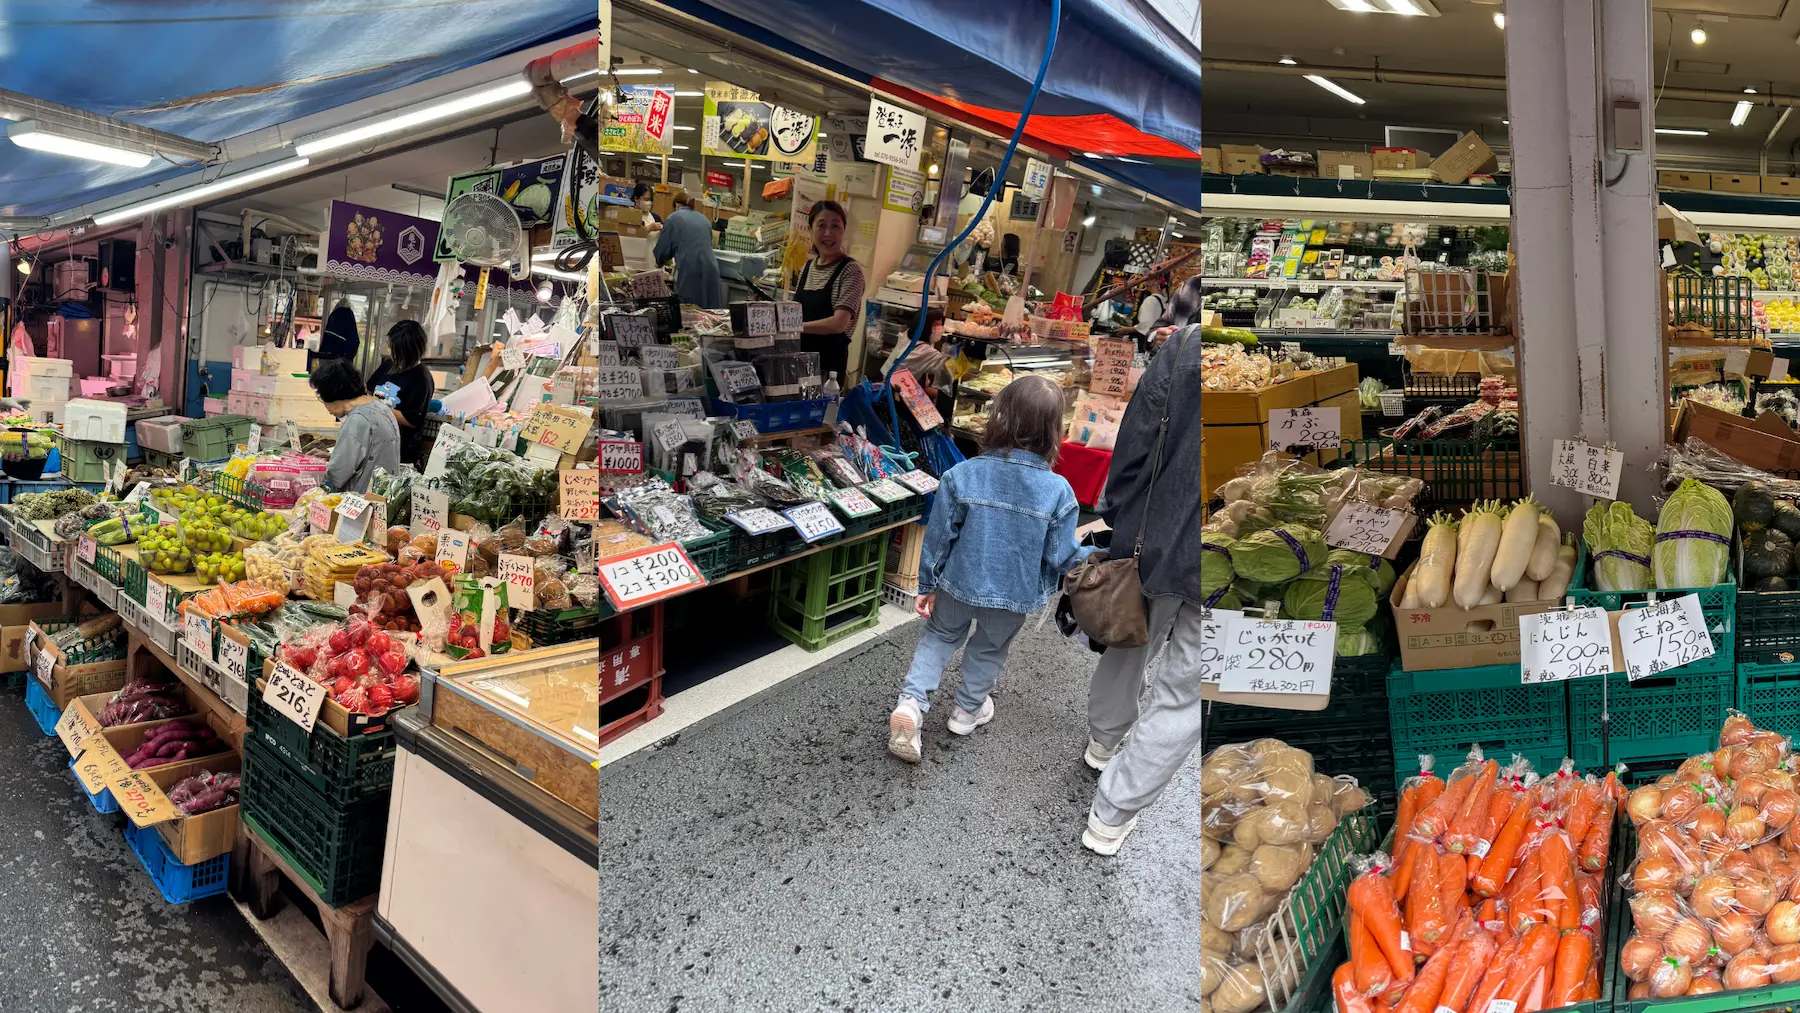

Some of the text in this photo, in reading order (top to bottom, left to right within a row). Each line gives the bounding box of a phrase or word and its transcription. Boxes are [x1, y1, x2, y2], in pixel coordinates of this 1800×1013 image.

[647, 93, 669, 134] 新米
[610, 371, 636, 384] ¥390
[1281, 418, 1319, 430] かぶ
[539, 429, 559, 447] 162
[601, 443, 641, 454] イタヤ貝柱
[603, 456, 640, 470] ¥1000
[1558, 453, 1575, 465] 大根
[1588, 458, 1611, 473] 白菜
[423, 516, 441, 531] 270
[805, 517, 836, 537] ¥150
[1345, 513, 1390, 528] キャベツ
[440, 533, 451, 547] 栗
[632, 551, 679, 574] ¥200
[510, 573, 533, 587] 270
[643, 564, 692, 591] ¥300
[1410, 613, 1431, 623] 予冷
[1639, 600, 1682, 622] 北海道
[186, 616, 201, 633] 人参
[1256, 621, 1296, 632] 北海道
[1633, 611, 1690, 644] 玉ねぎ
[1238, 630, 1318, 647] じゃがいも
[1529, 622, 1588, 645] にんじん
[193, 637, 207, 652] 162
[219, 636, 245, 656] きゅうり
[1658, 630, 1707, 657] 150円
[1246, 647, 1315, 673] 280円
[1549, 643, 1609, 664] 200円
[1649, 660, 1672, 675] 税込
[1676, 645, 1711, 666] 162円
[1567, 658, 1609, 678] 216円
[1249, 679, 1315, 692] 税込302円
[276, 685, 306, 714] 216
[126, 788, 148, 809] 270
